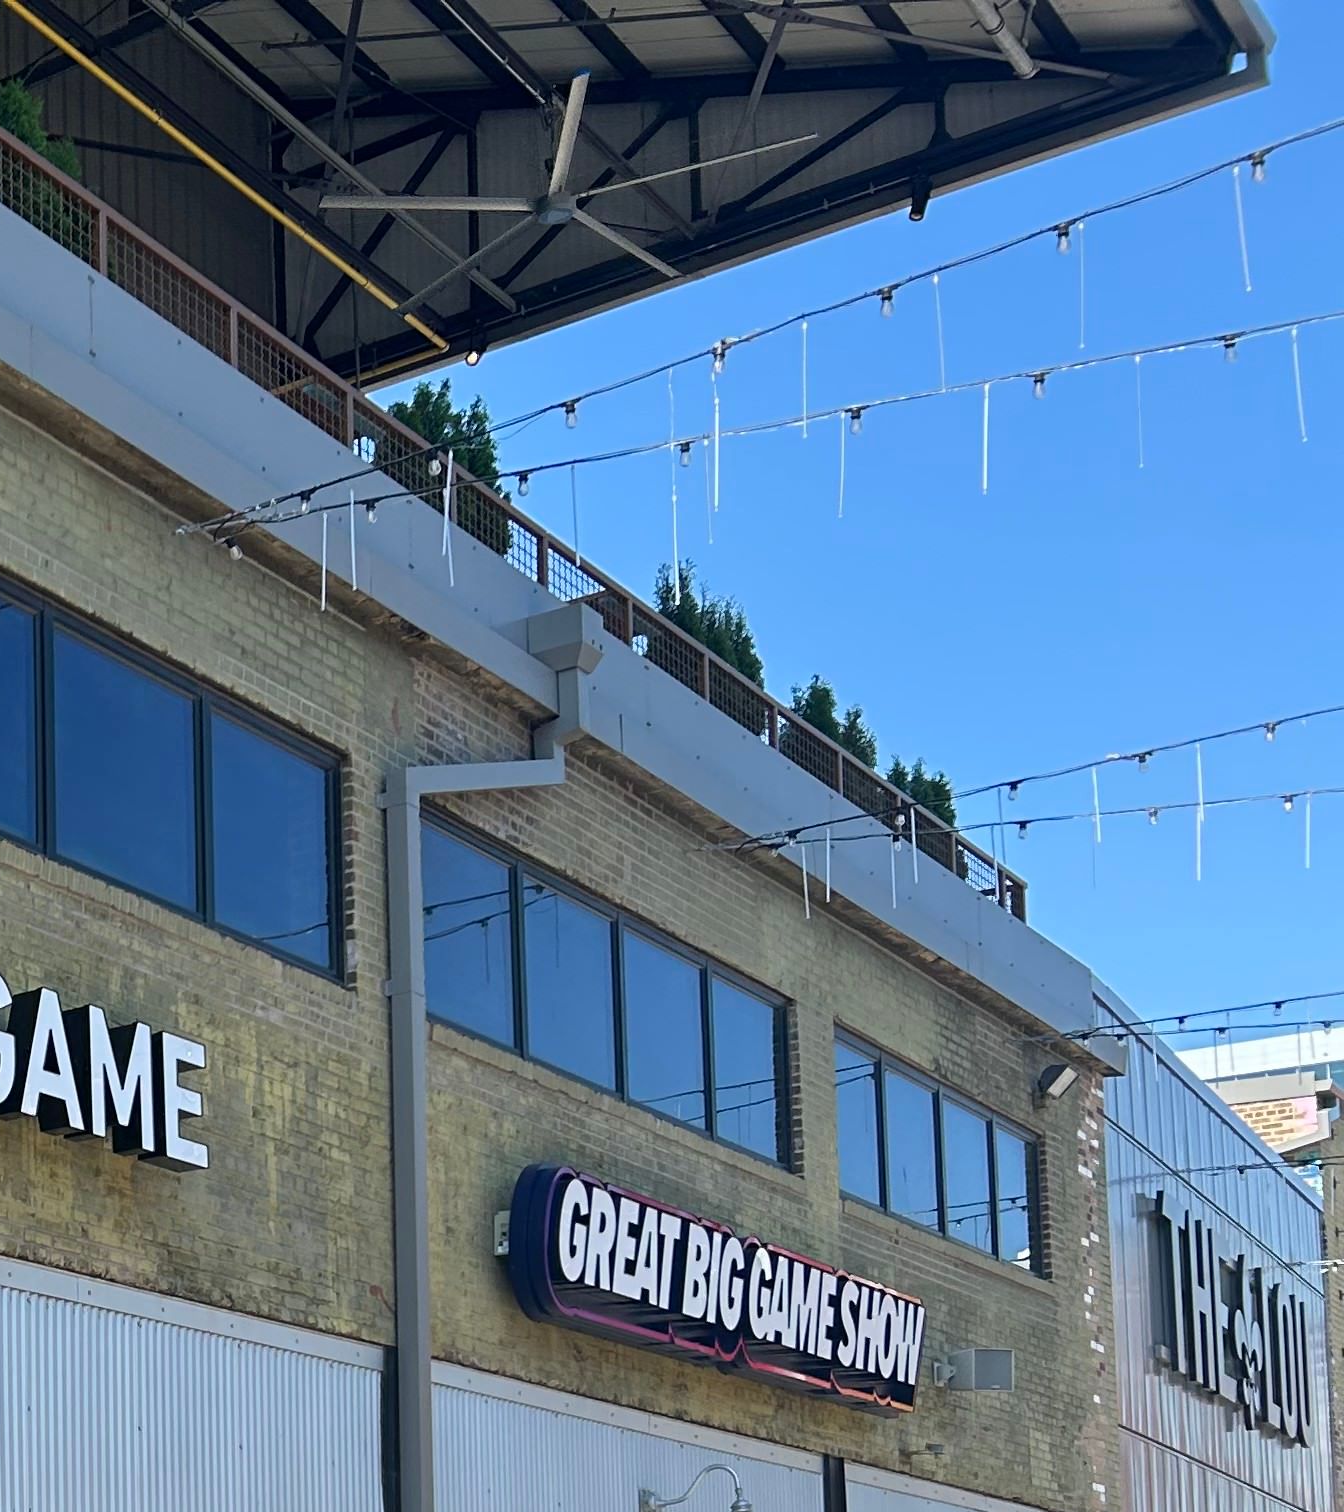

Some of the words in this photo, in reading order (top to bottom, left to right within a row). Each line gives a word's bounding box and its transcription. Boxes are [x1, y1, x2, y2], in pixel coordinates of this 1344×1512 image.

[559, 1178, 681, 1310] GREAT
[682, 1222, 745, 1331] BIG
[748, 1247, 837, 1360] GAME
[837, 1278, 925, 1385] SHOW
[1157, 1190, 1239, 1403] THE
